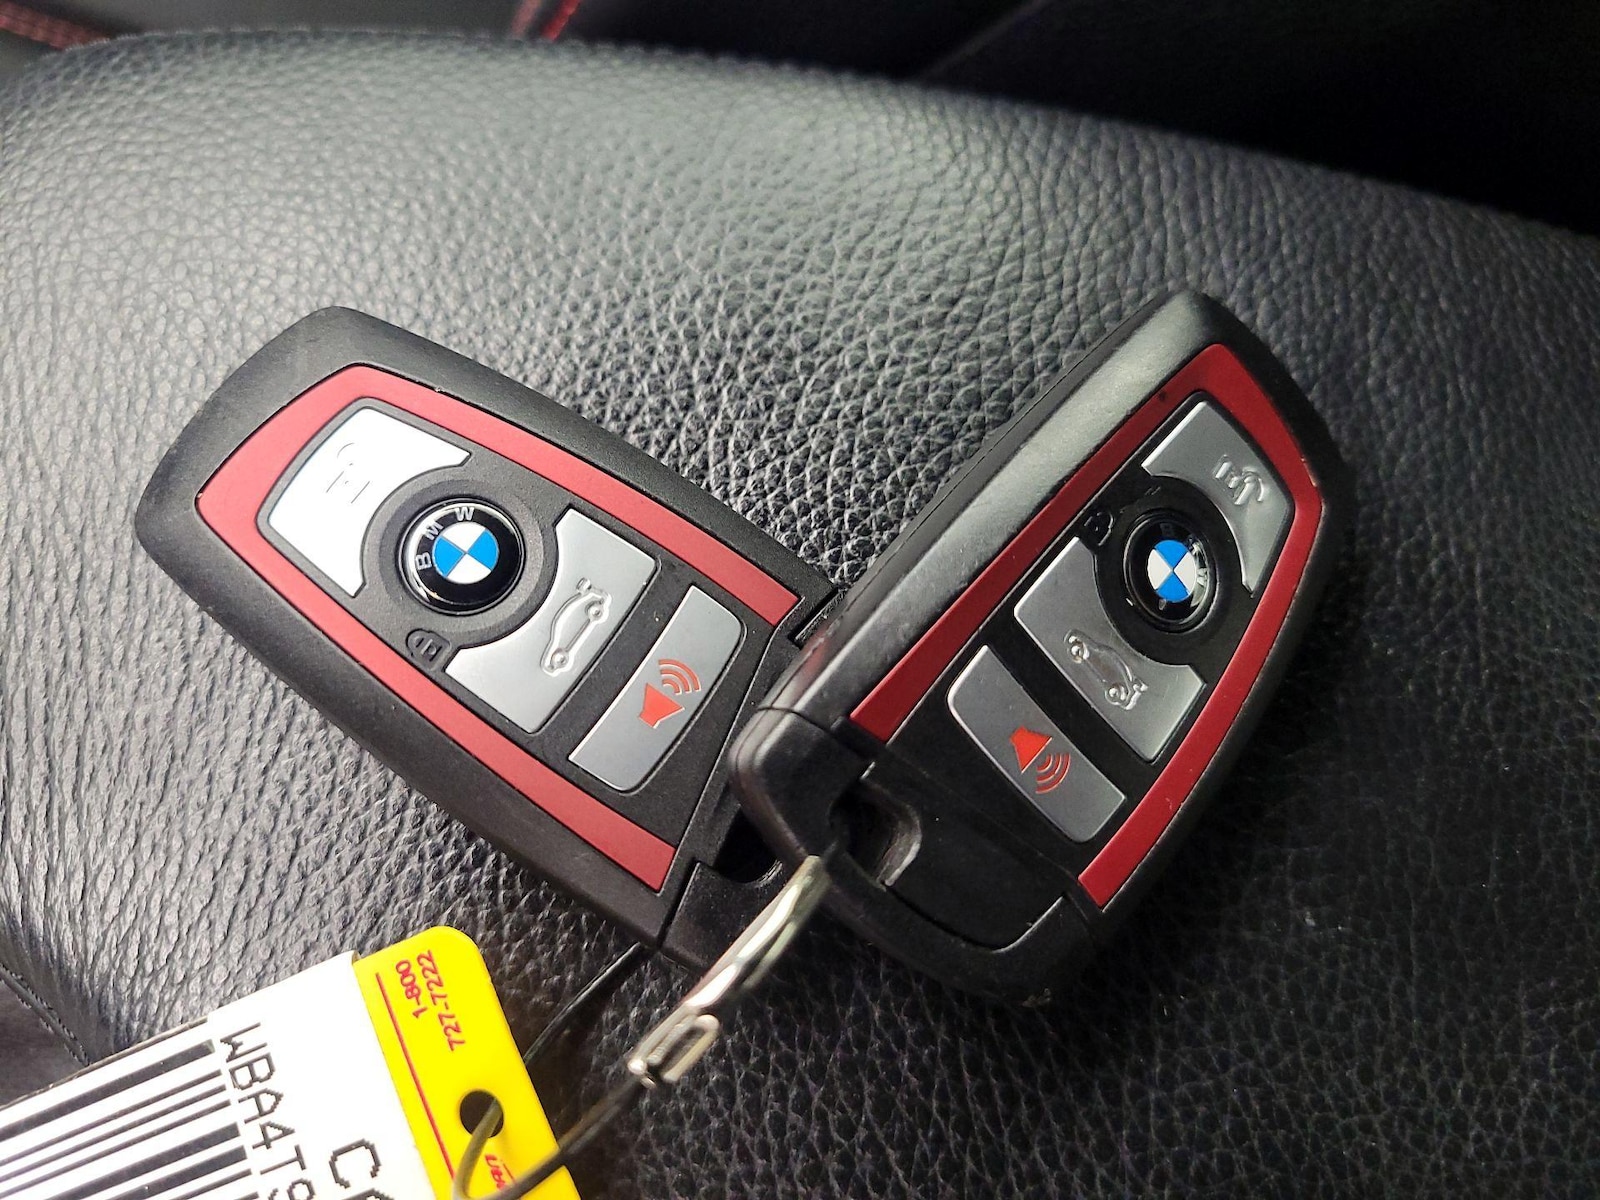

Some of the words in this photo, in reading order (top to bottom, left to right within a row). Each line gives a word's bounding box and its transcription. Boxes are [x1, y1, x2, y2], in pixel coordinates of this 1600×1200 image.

[416, 507, 475, 570] BMW
[396, 960, 428, 1018] 1-800
[416, 949, 466, 1051] 727-7222
